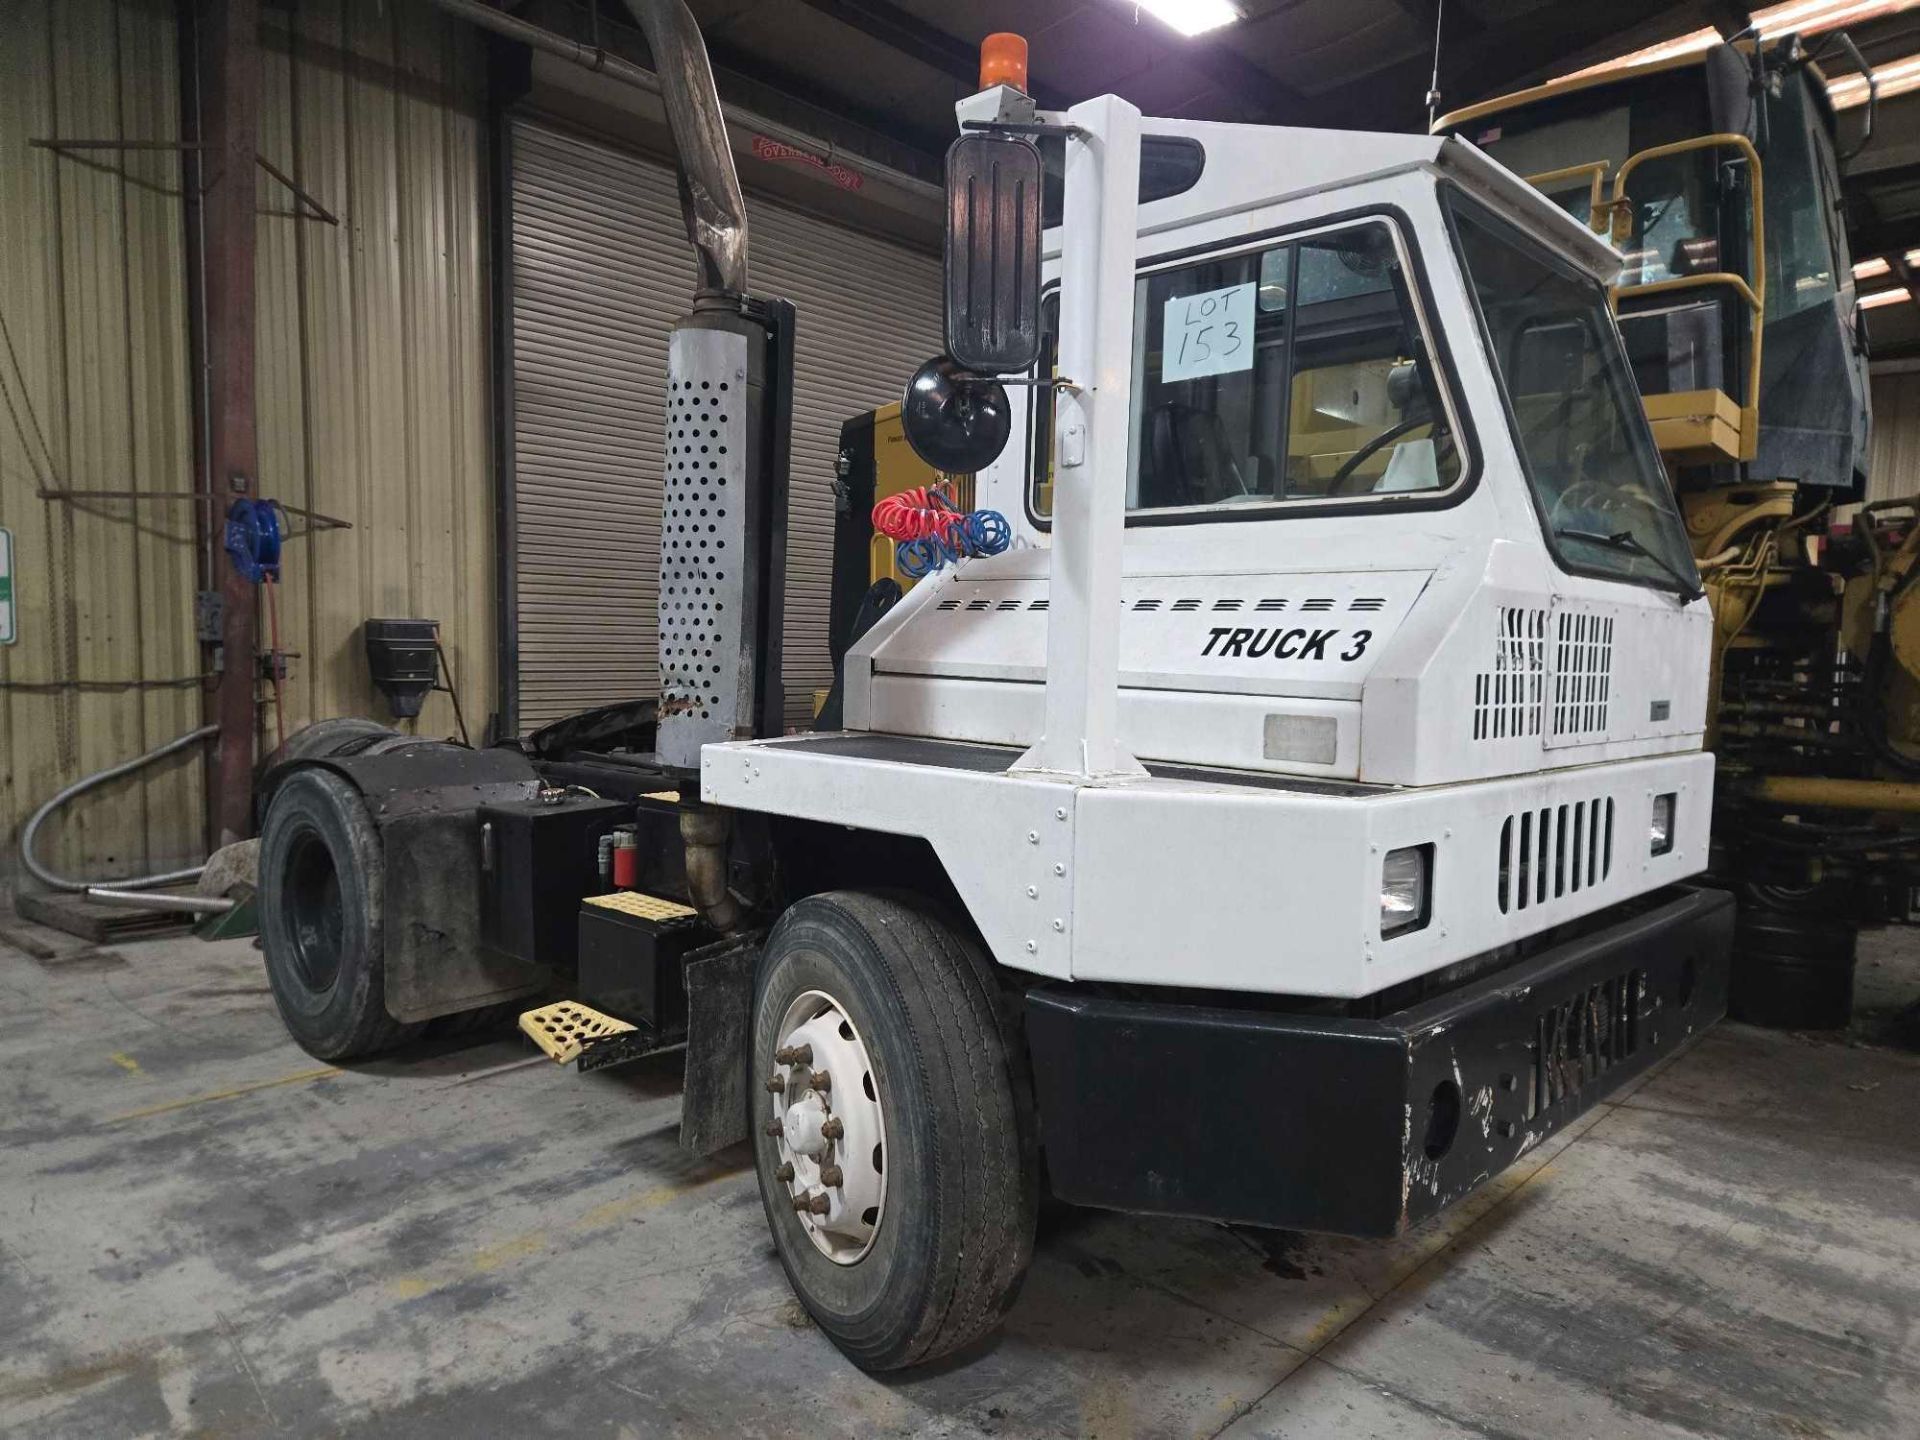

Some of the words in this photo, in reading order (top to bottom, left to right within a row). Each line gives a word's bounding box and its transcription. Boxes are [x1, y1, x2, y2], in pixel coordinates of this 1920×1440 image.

[1185, 288, 1241, 326] LOT
[1178, 321, 1242, 366] 153
[1201, 627, 1341, 660] TRUCK
[1340, 629, 1373, 662] 3
